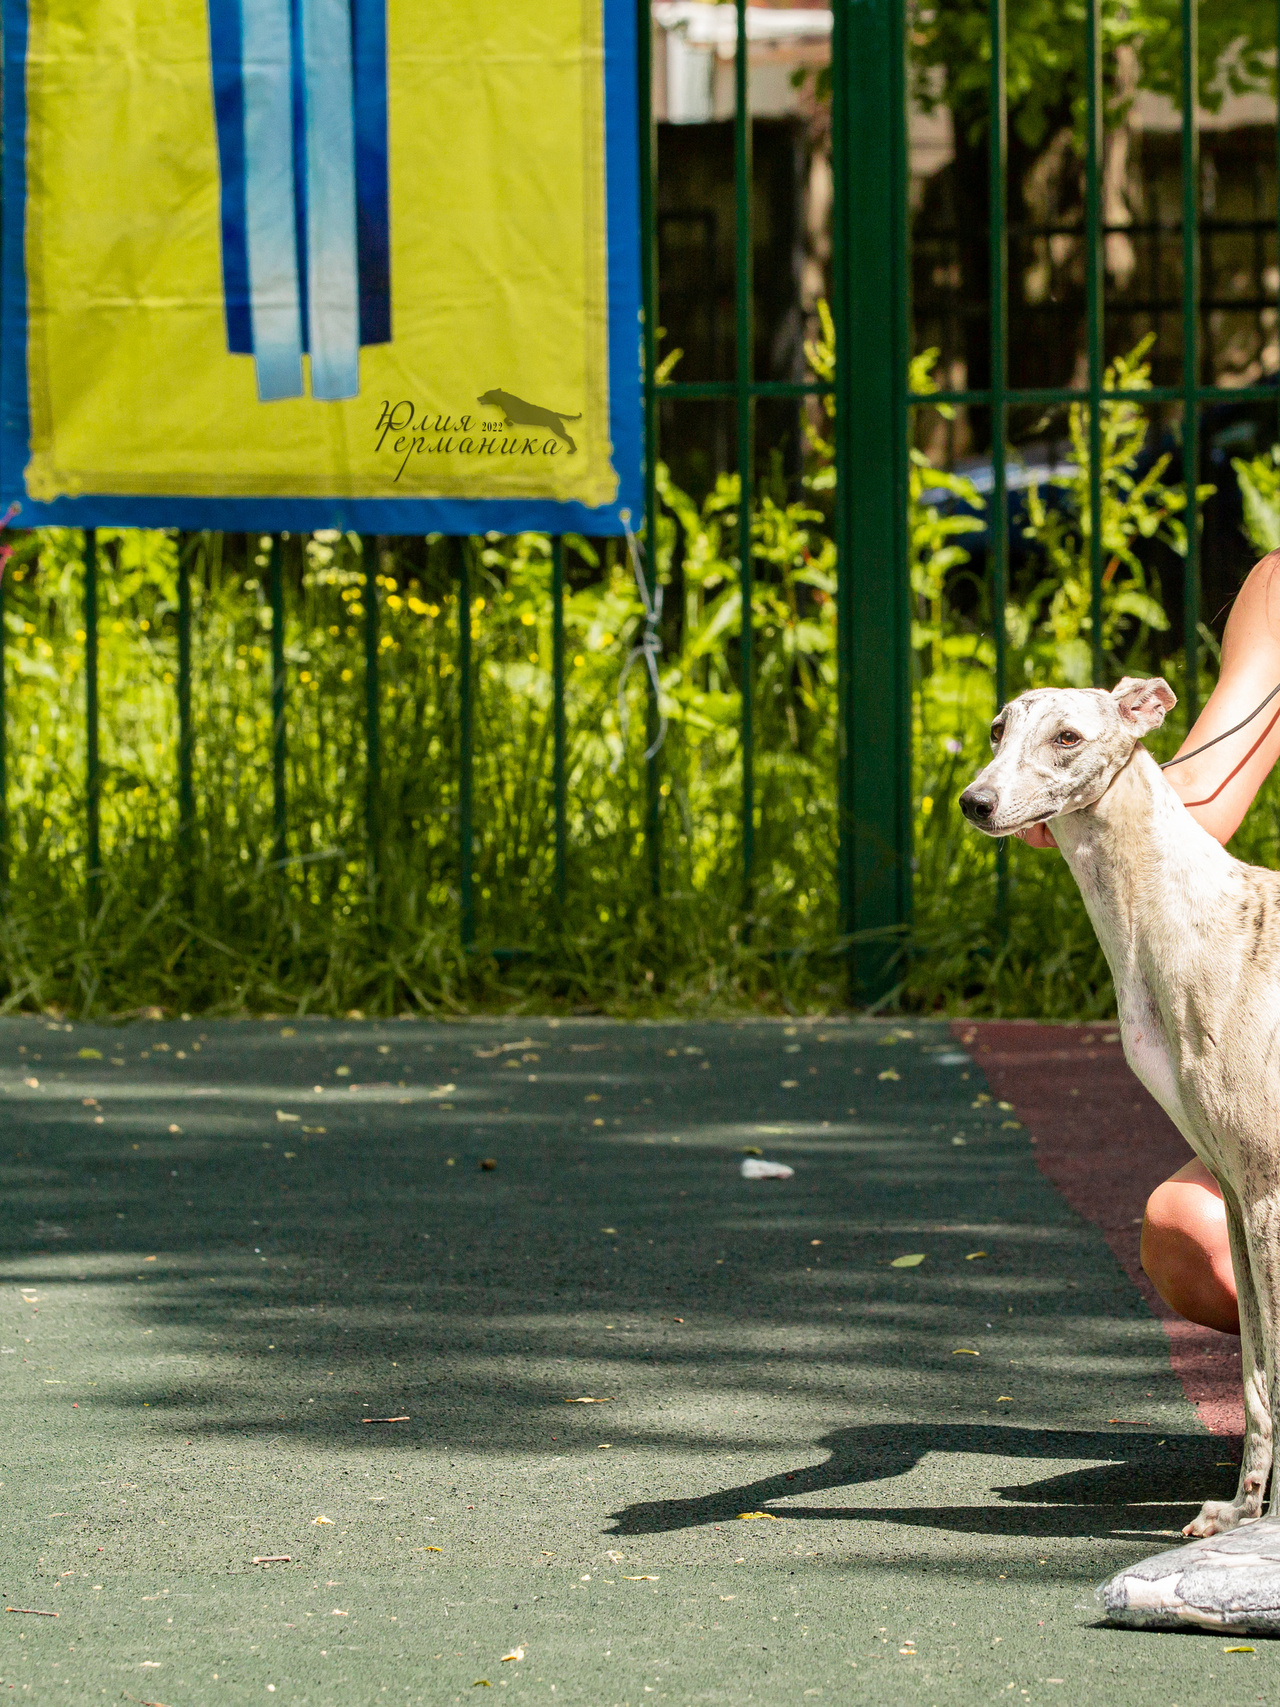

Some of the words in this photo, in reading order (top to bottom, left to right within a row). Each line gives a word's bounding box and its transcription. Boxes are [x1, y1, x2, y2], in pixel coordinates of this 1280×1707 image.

[375, 400, 476, 431] Юлия
[481, 422, 503, 433] 2022
[374, 422, 563, 482] Германика
